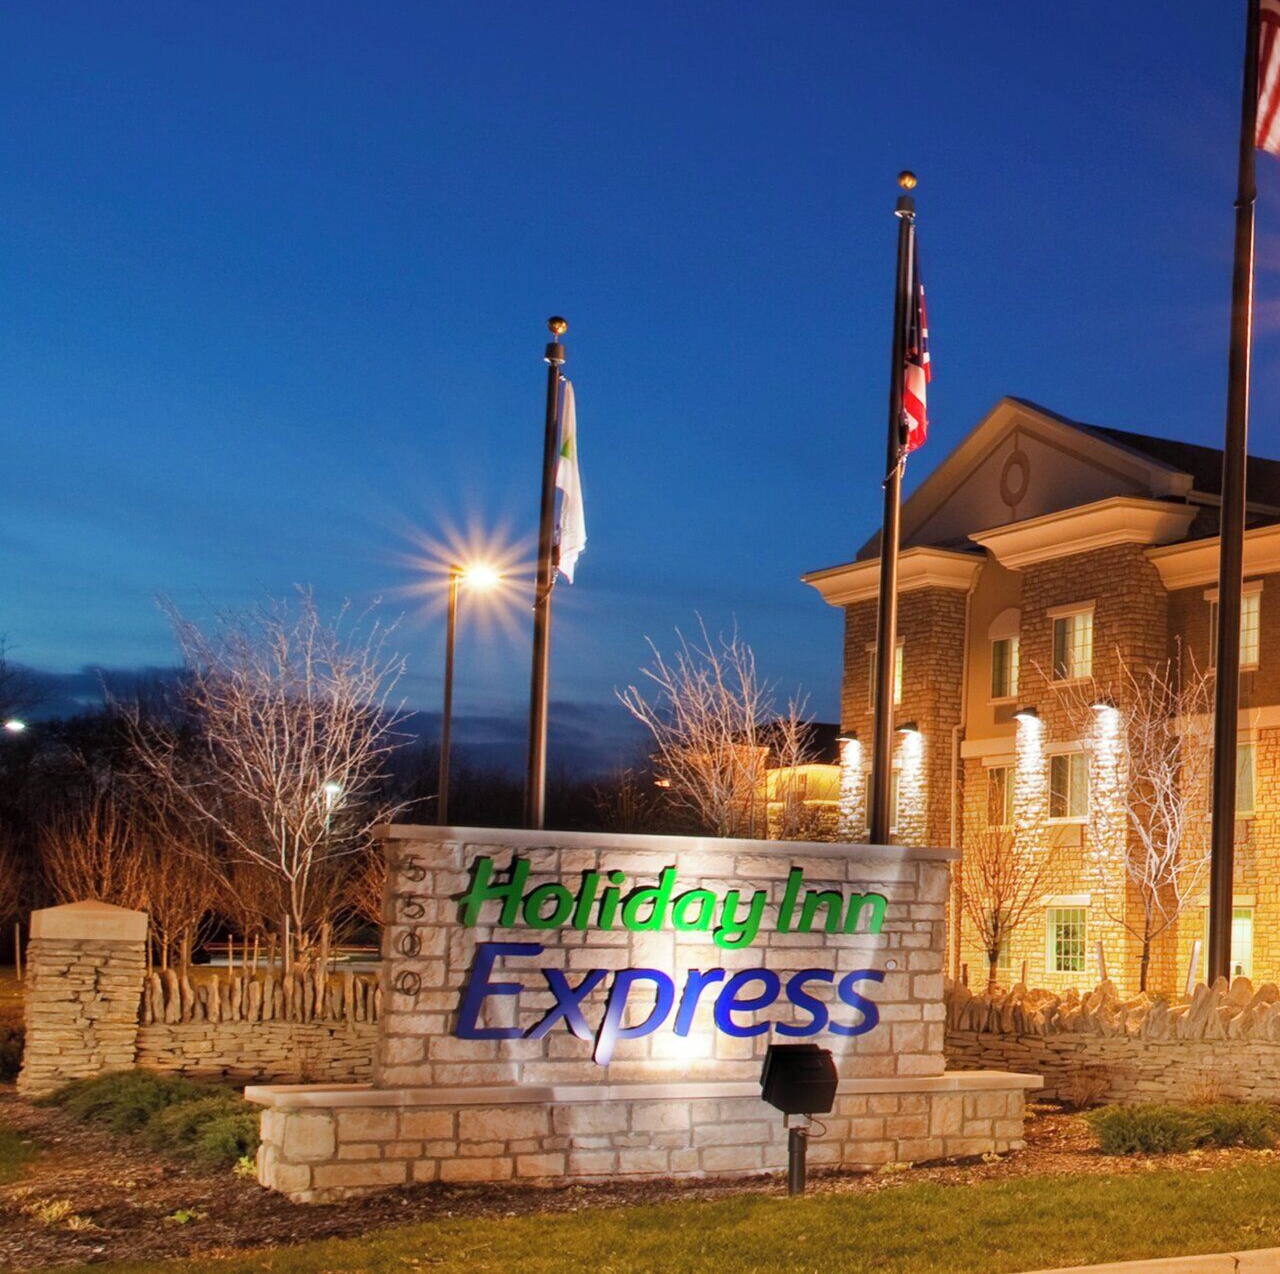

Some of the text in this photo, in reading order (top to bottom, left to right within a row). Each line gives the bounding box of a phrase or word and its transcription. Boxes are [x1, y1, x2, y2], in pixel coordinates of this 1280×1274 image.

[402, 855, 427, 996] 5500
[459, 856, 888, 950] Holiday Inn
[456, 942, 887, 1066] Express
